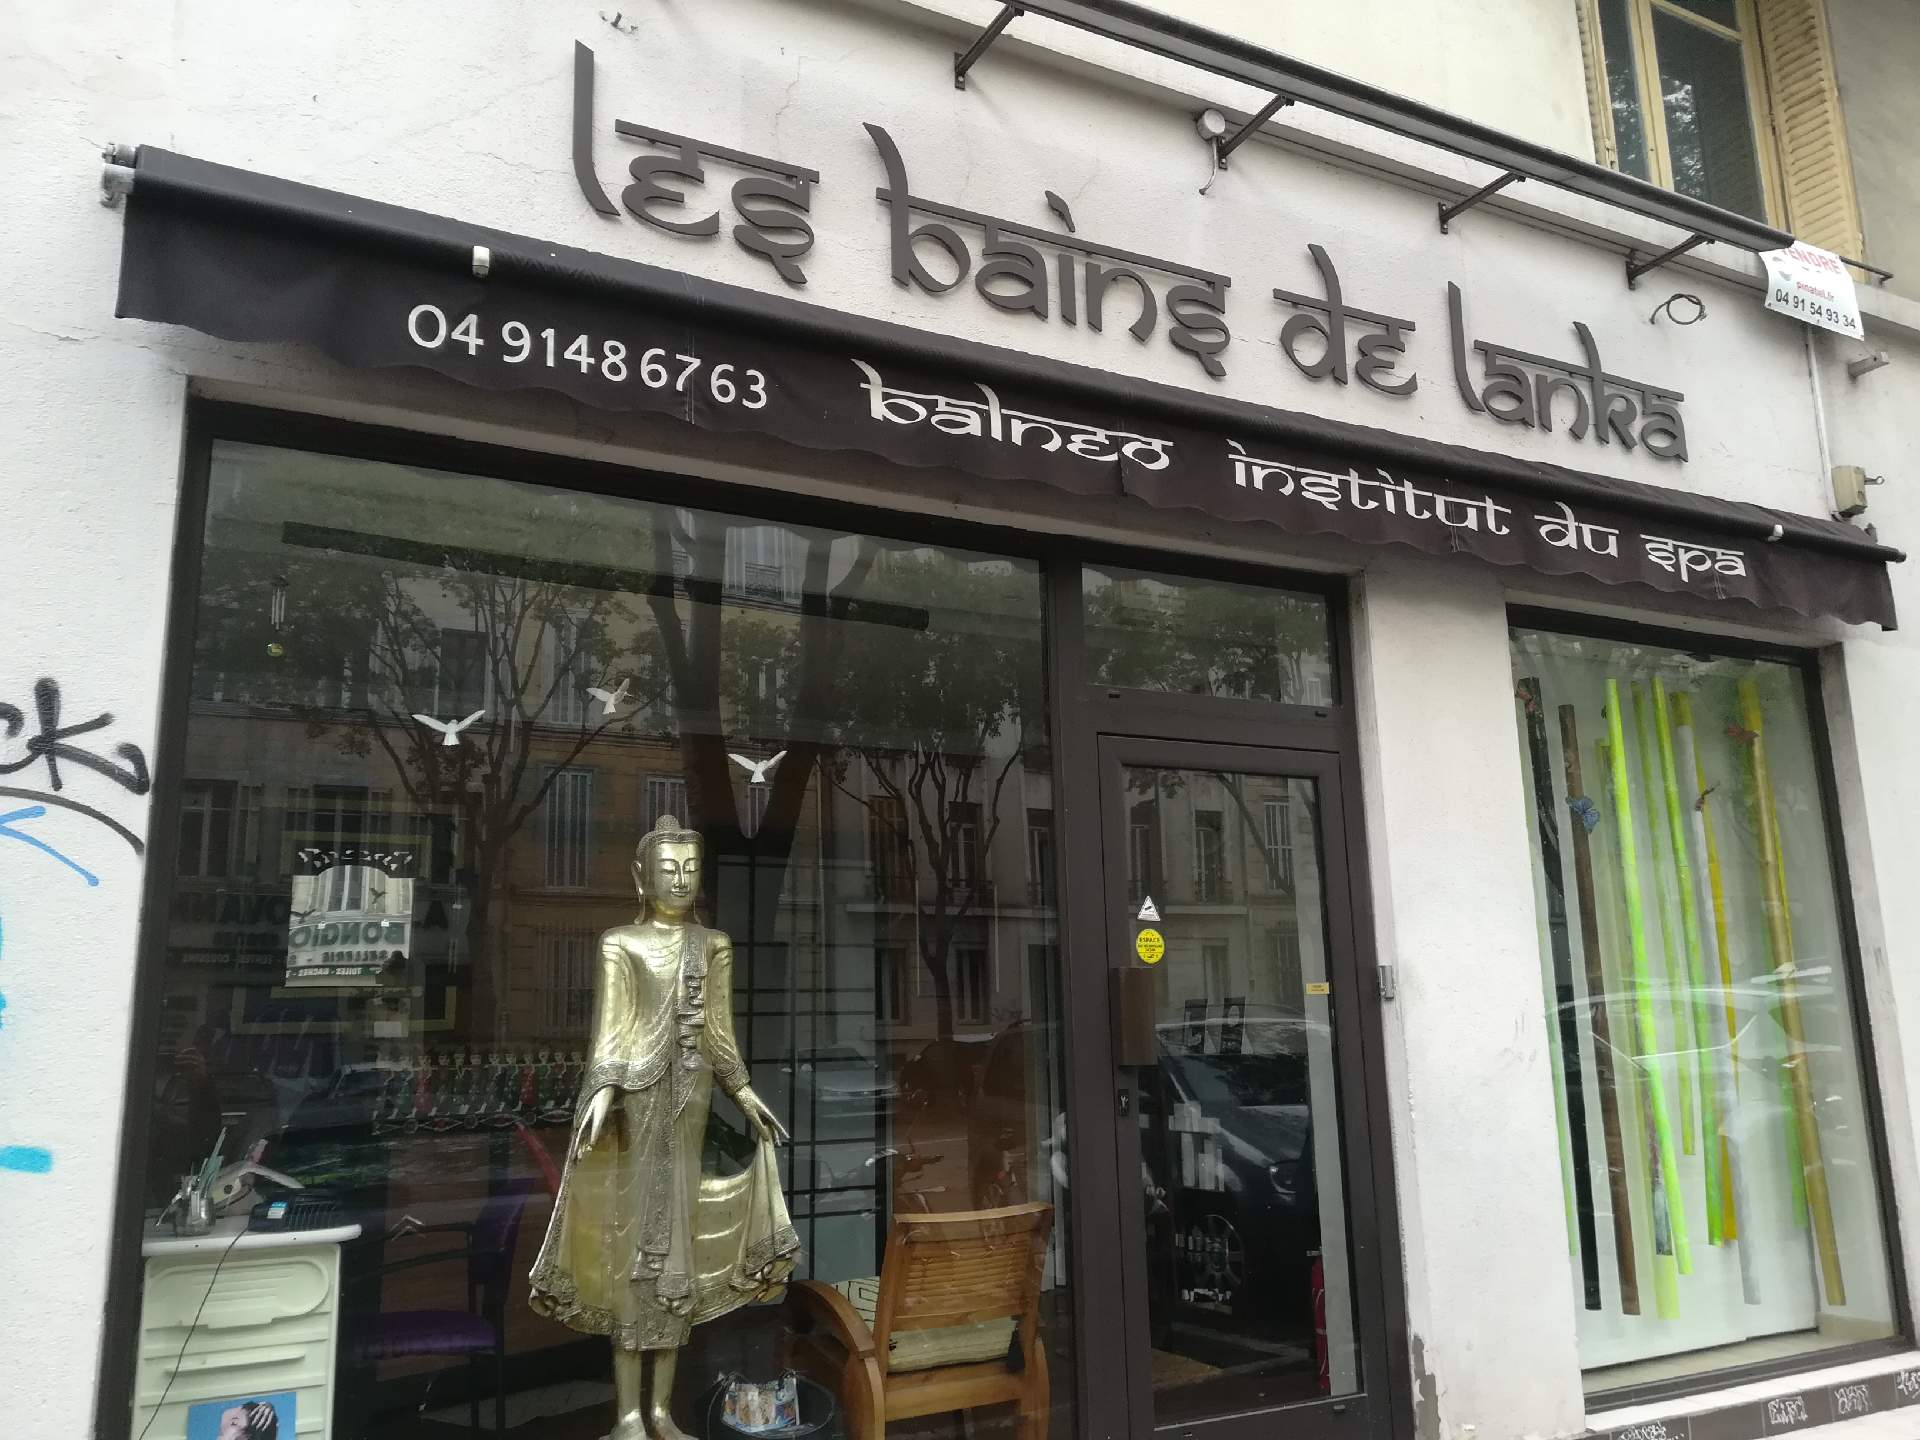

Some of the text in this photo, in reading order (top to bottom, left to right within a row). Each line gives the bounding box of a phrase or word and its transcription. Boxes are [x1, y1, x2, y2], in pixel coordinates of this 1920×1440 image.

[863, 121, 1231, 376] bains
[1273, 243, 1417, 395] de
[1775, 289, 1856, 329] 04 91 54 93 34
[407, 303, 485, 356] 04
[850, 358, 1174, 471] balneo
[1226, 438, 1512, 536] institut
[1534, 501, 1620, 558] du
[1640, 532, 1747, 583] spa
